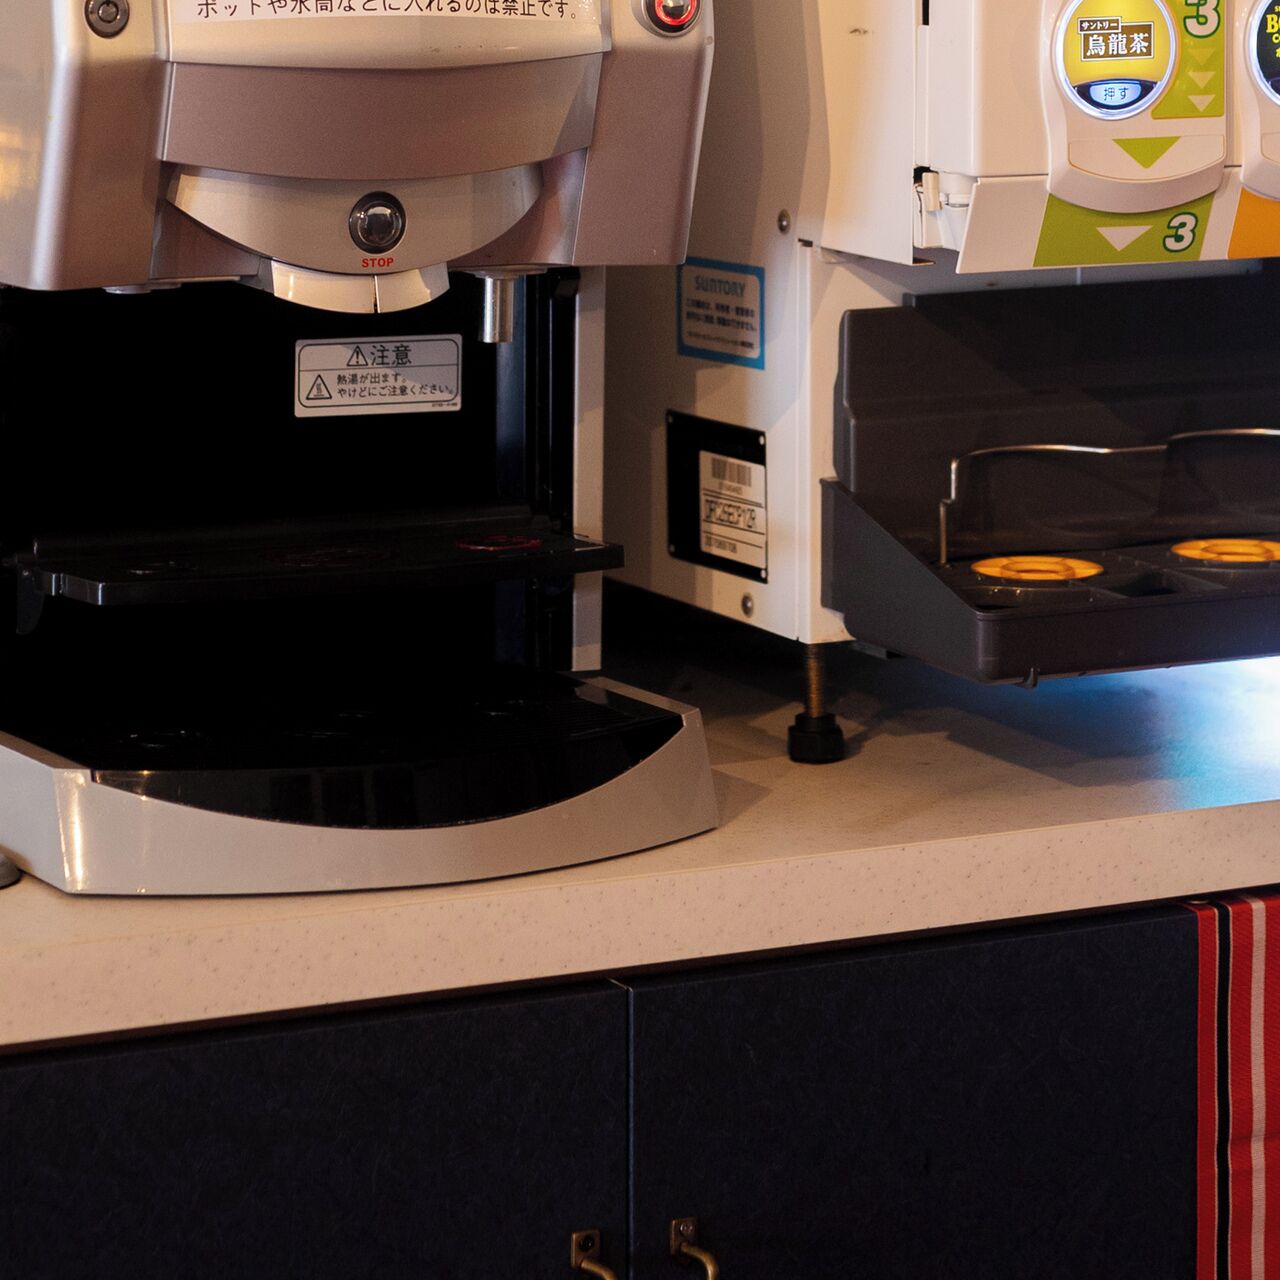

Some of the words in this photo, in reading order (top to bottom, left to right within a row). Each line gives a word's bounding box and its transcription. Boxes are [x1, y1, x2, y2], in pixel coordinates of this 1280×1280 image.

[1082, 21, 1118, 30] サントリー
[1086, 33, 1149, 56] 烏龍茶
[1104, 87, 1128, 101] 押す
[1162, 212, 1198, 252] 3
[361, 257, 394, 268] STOP
[695, 276, 746, 298] SUNTORY
[370, 344, 412, 366] 注意
[337, 373, 406, 386] 熱湯が出ます。
[337, 384, 454, 398] やけどにご注意ください。
